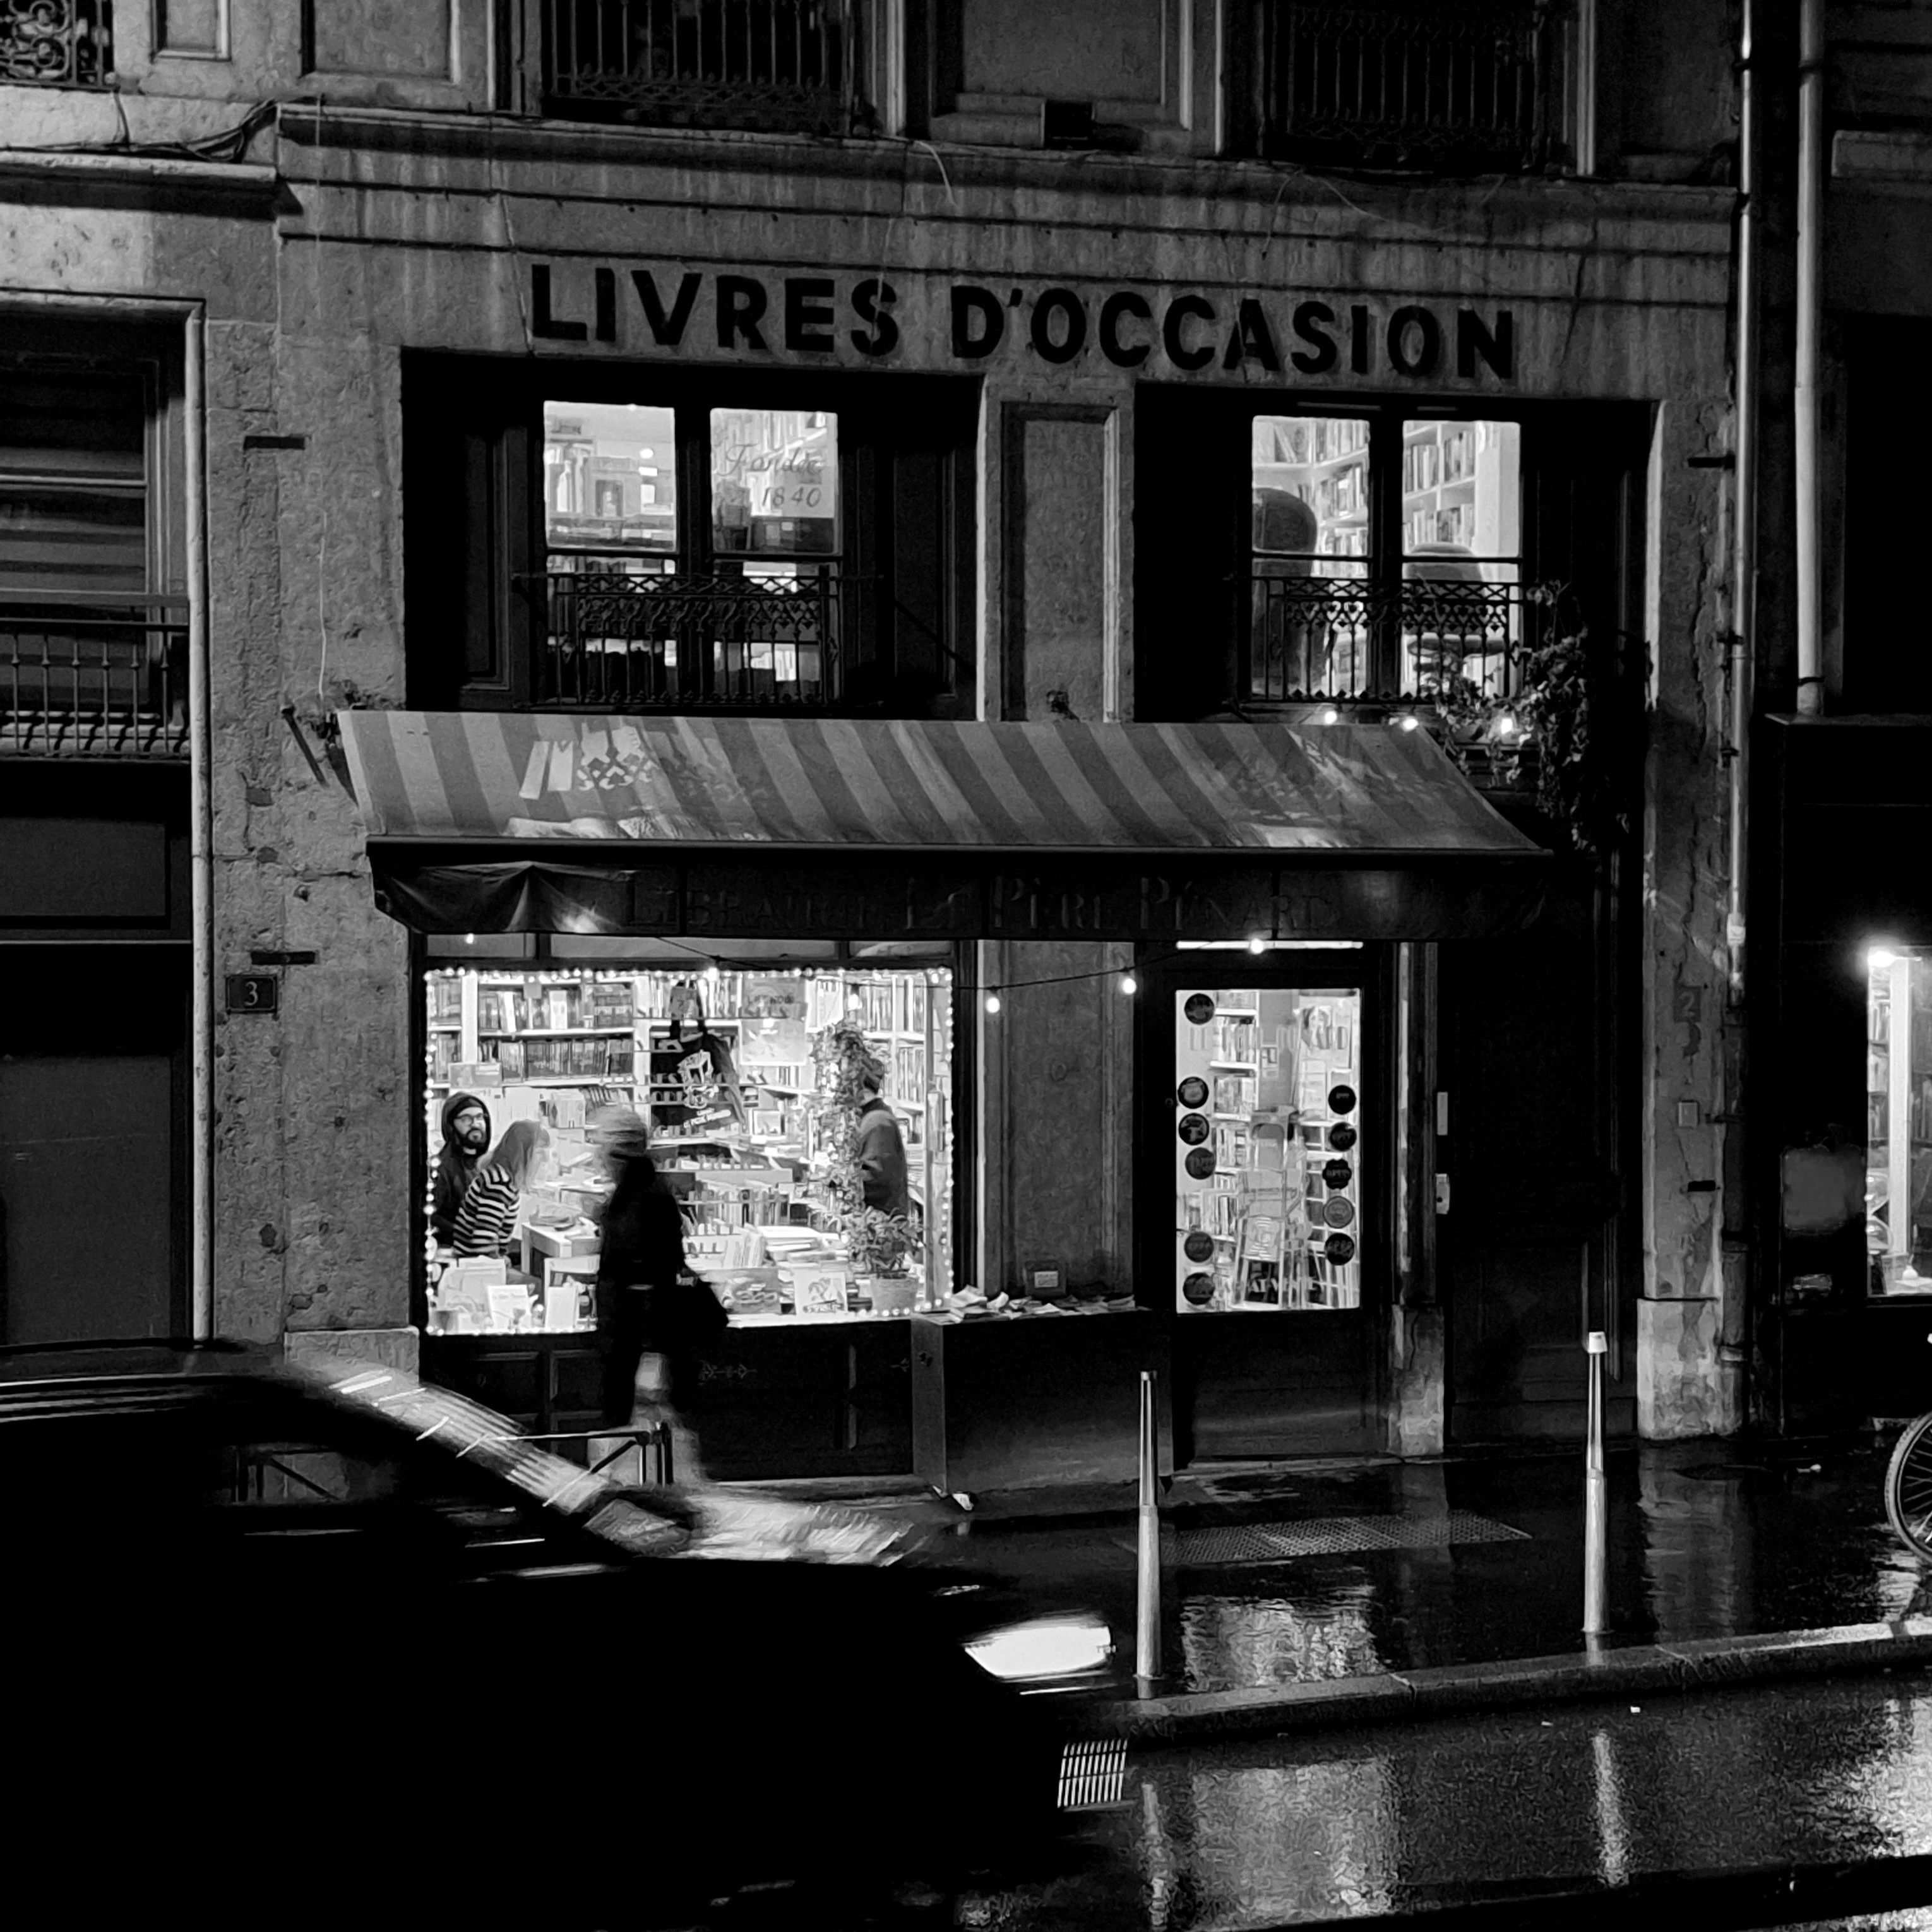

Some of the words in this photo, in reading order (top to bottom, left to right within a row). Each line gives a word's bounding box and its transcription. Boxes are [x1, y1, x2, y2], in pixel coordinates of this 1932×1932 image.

[532, 264, 899, 358] LIVRES
[950, 285, 1513, 379] D'OCCASION
[761, 486, 821, 508] 1840
[244, 981, 258, 1006] 3
